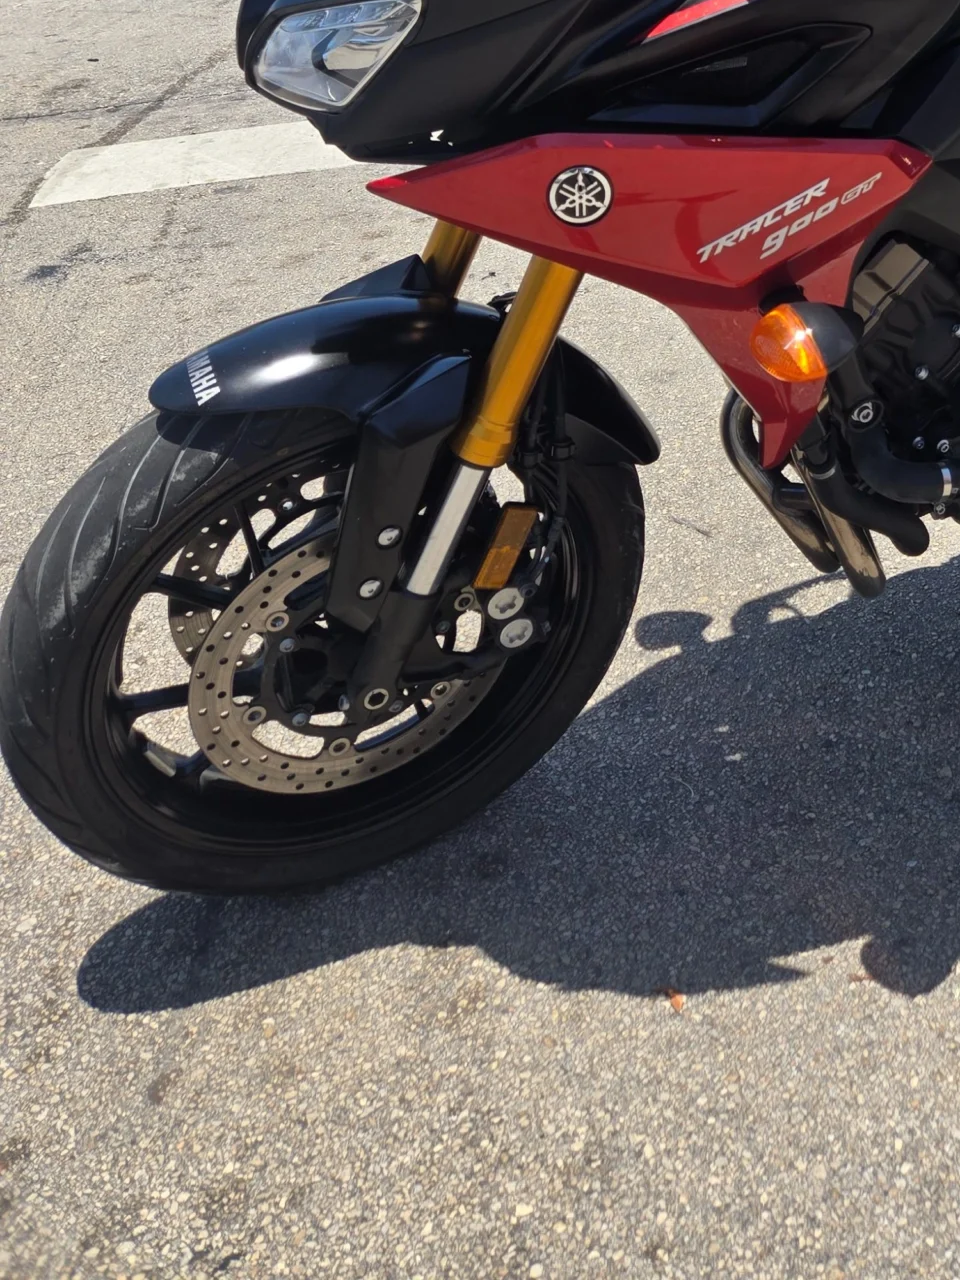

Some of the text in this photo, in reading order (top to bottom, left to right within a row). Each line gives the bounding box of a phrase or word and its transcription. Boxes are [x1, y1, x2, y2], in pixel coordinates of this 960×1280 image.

[696, 177, 830, 263] TRACER
[760, 172, 882, 260] 900 GT
[186, 350, 221, 406] AMAHA
